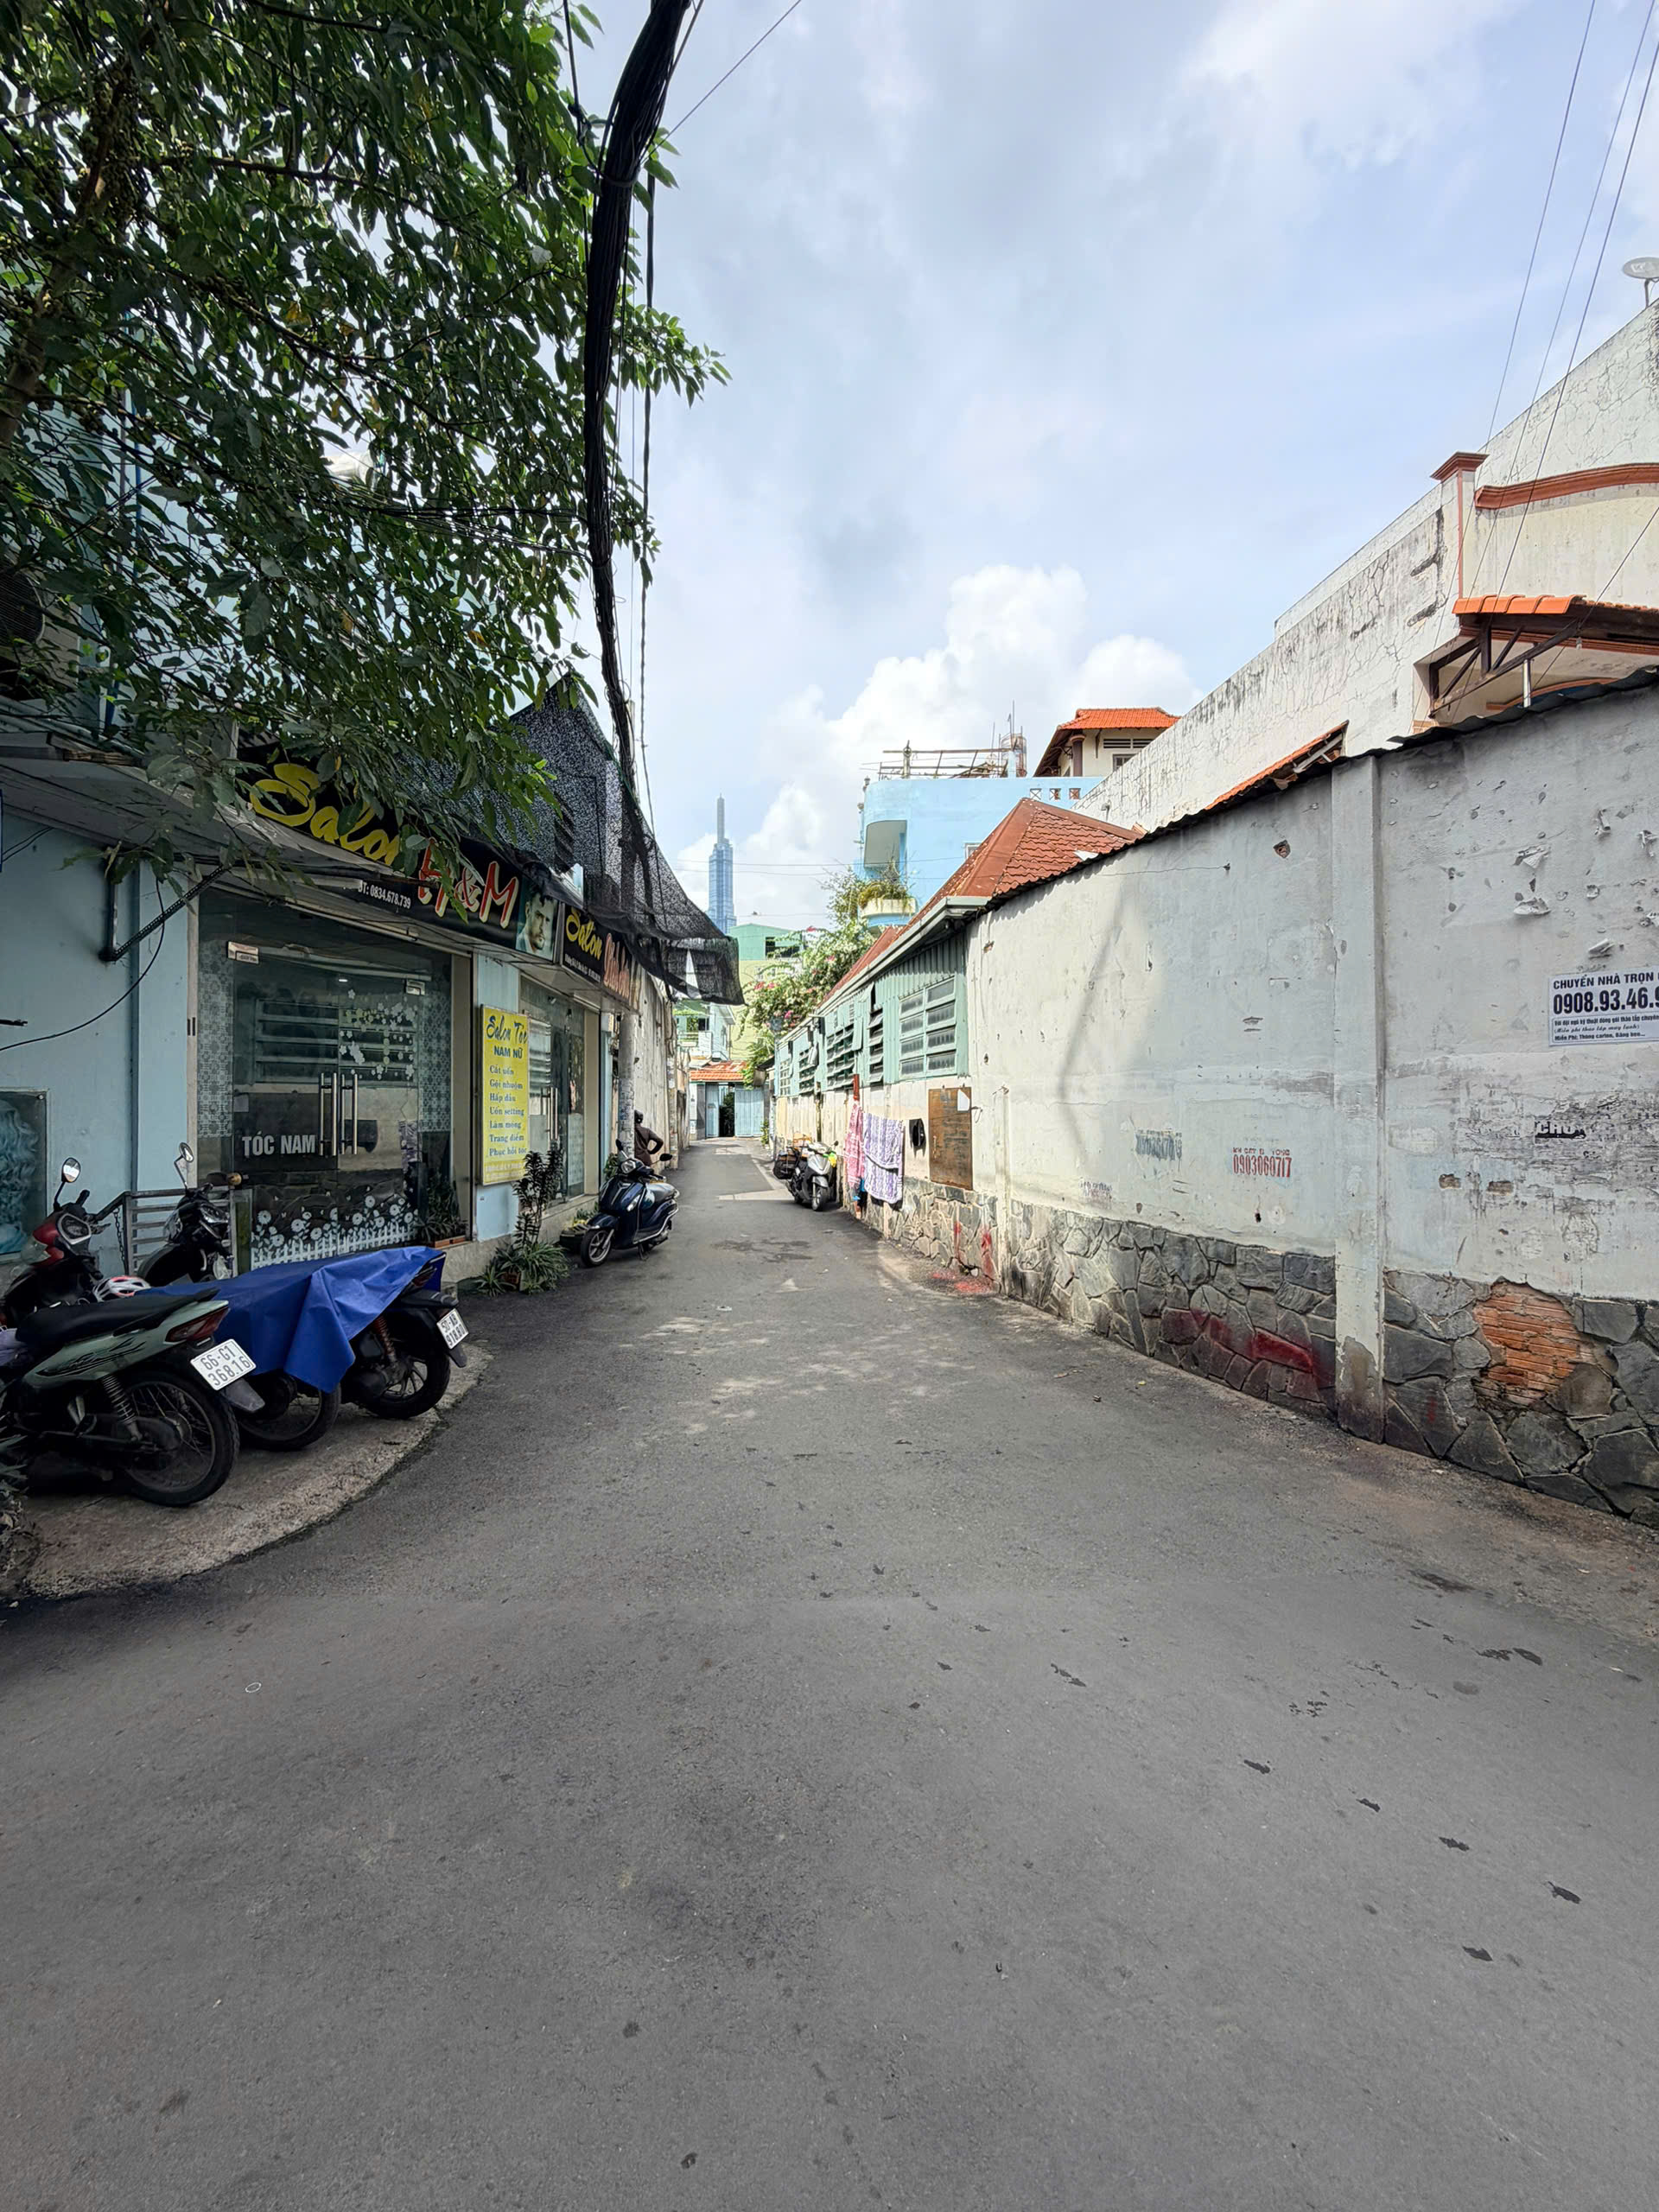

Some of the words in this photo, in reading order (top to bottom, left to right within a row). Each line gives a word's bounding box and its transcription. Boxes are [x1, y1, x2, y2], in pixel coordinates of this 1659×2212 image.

[370, 884, 411, 909] 0834.678.739
[566, 906, 602, 961] Salon
[1553, 974, 1594, 990] CHUYỂN
[1598, 973, 1621, 986] NHÀ
[1624, 972, 1654, 985] TRỌN
[486, 1015, 512, 1041] Salon
[493, 1045, 511, 1058] NAM
[242, 1130, 275, 1156] TÓC
[281, 1134, 316, 1154] NAM
[1233, 1154, 1293, 1178] 0903060717
[200, 1344, 236, 1370] 66-G1
[207, 1356, 251, 1386] 368.16
